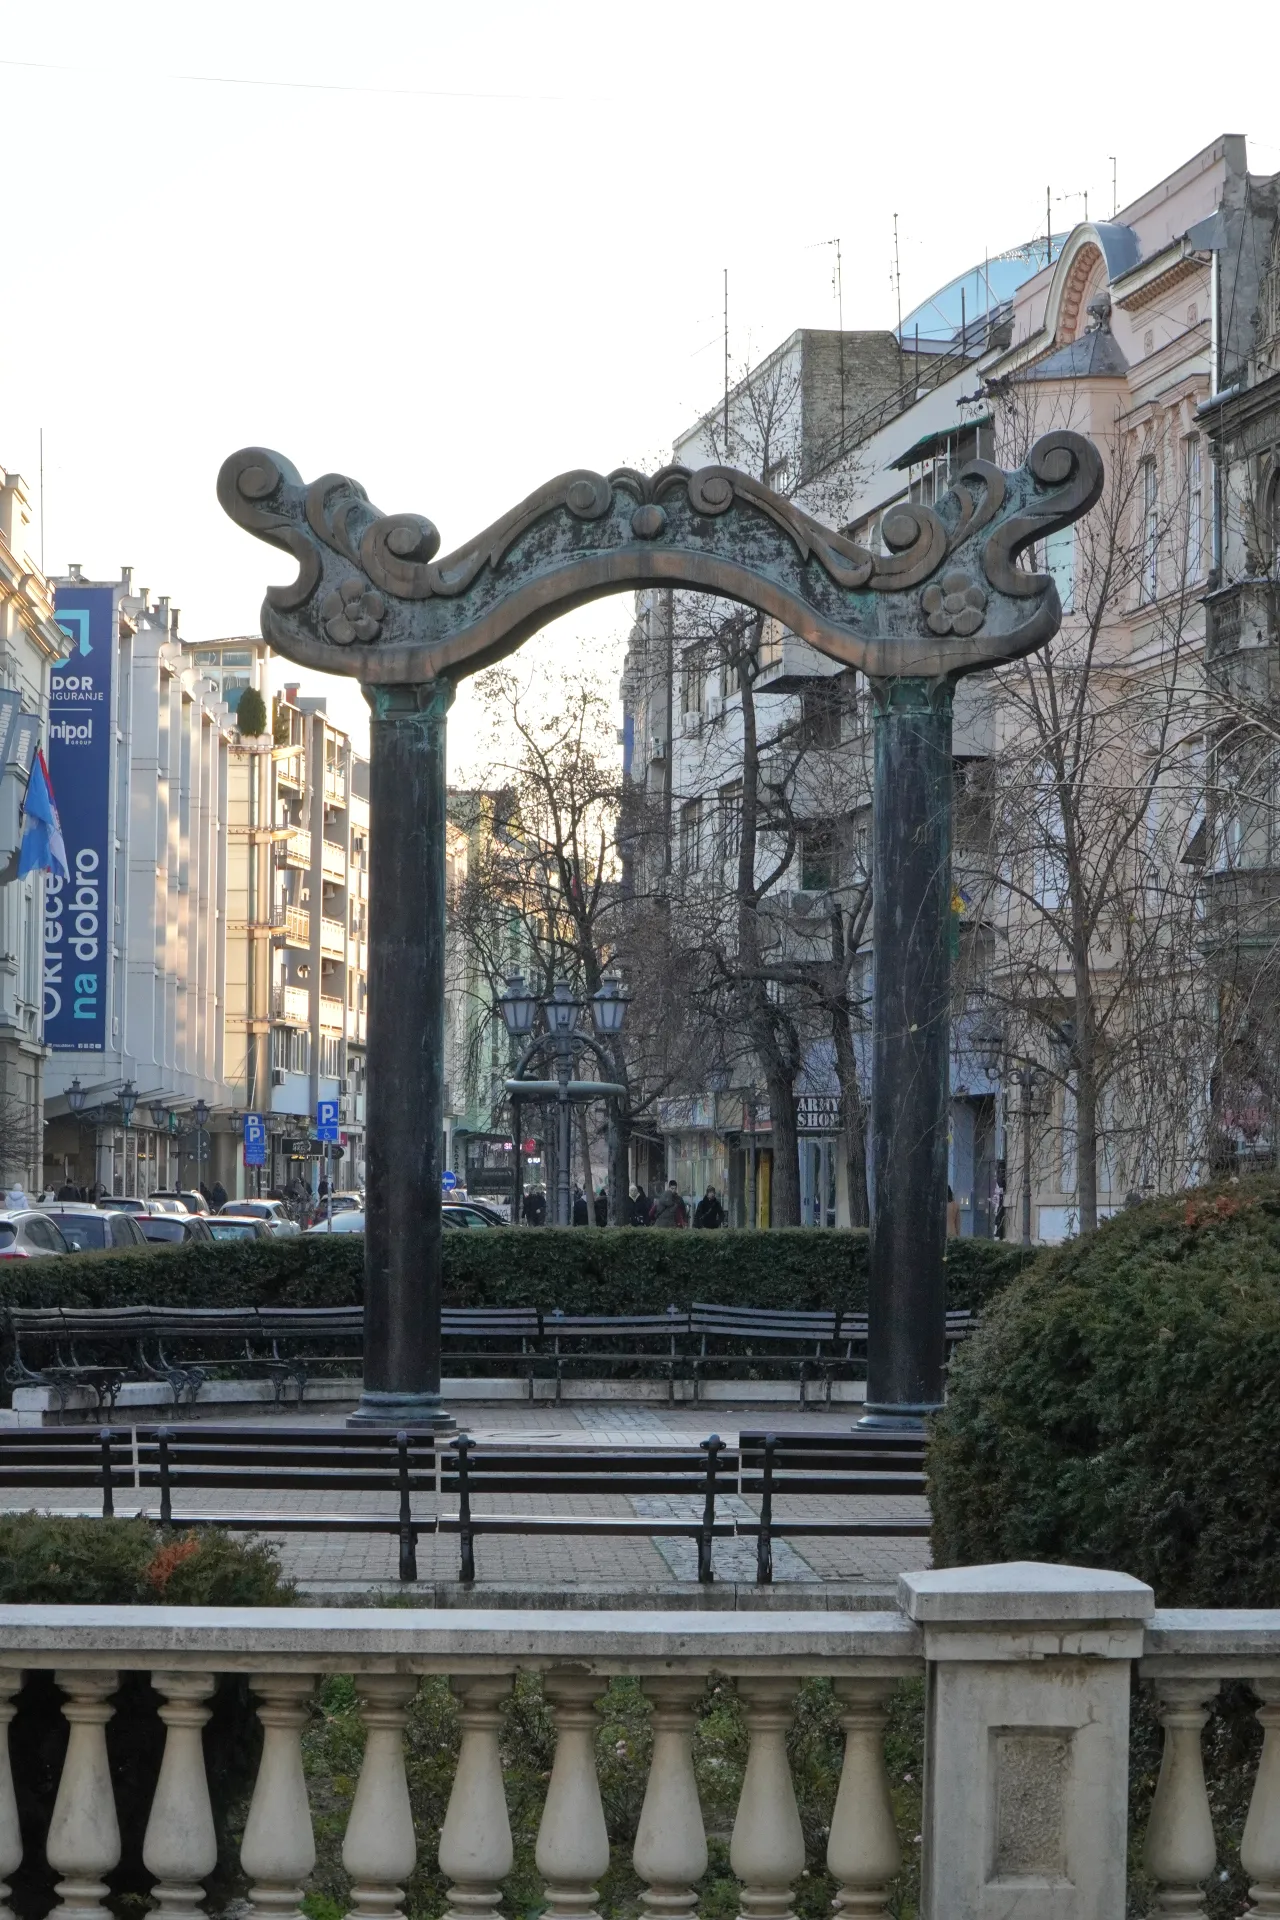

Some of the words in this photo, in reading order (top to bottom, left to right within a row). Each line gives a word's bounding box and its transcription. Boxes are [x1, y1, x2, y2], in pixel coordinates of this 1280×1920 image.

[52, 676, 93, 690] DOR
[49, 719, 92, 745] nipol
[68, 848, 99, 961] dobro
[74, 973, 97, 1019] na
[797, 1098, 840, 1111] ARMY
[322, 1105, 333, 1124] P
[797, 1113, 840, 1126] SHOP
[250, 1128, 260, 1142] P
